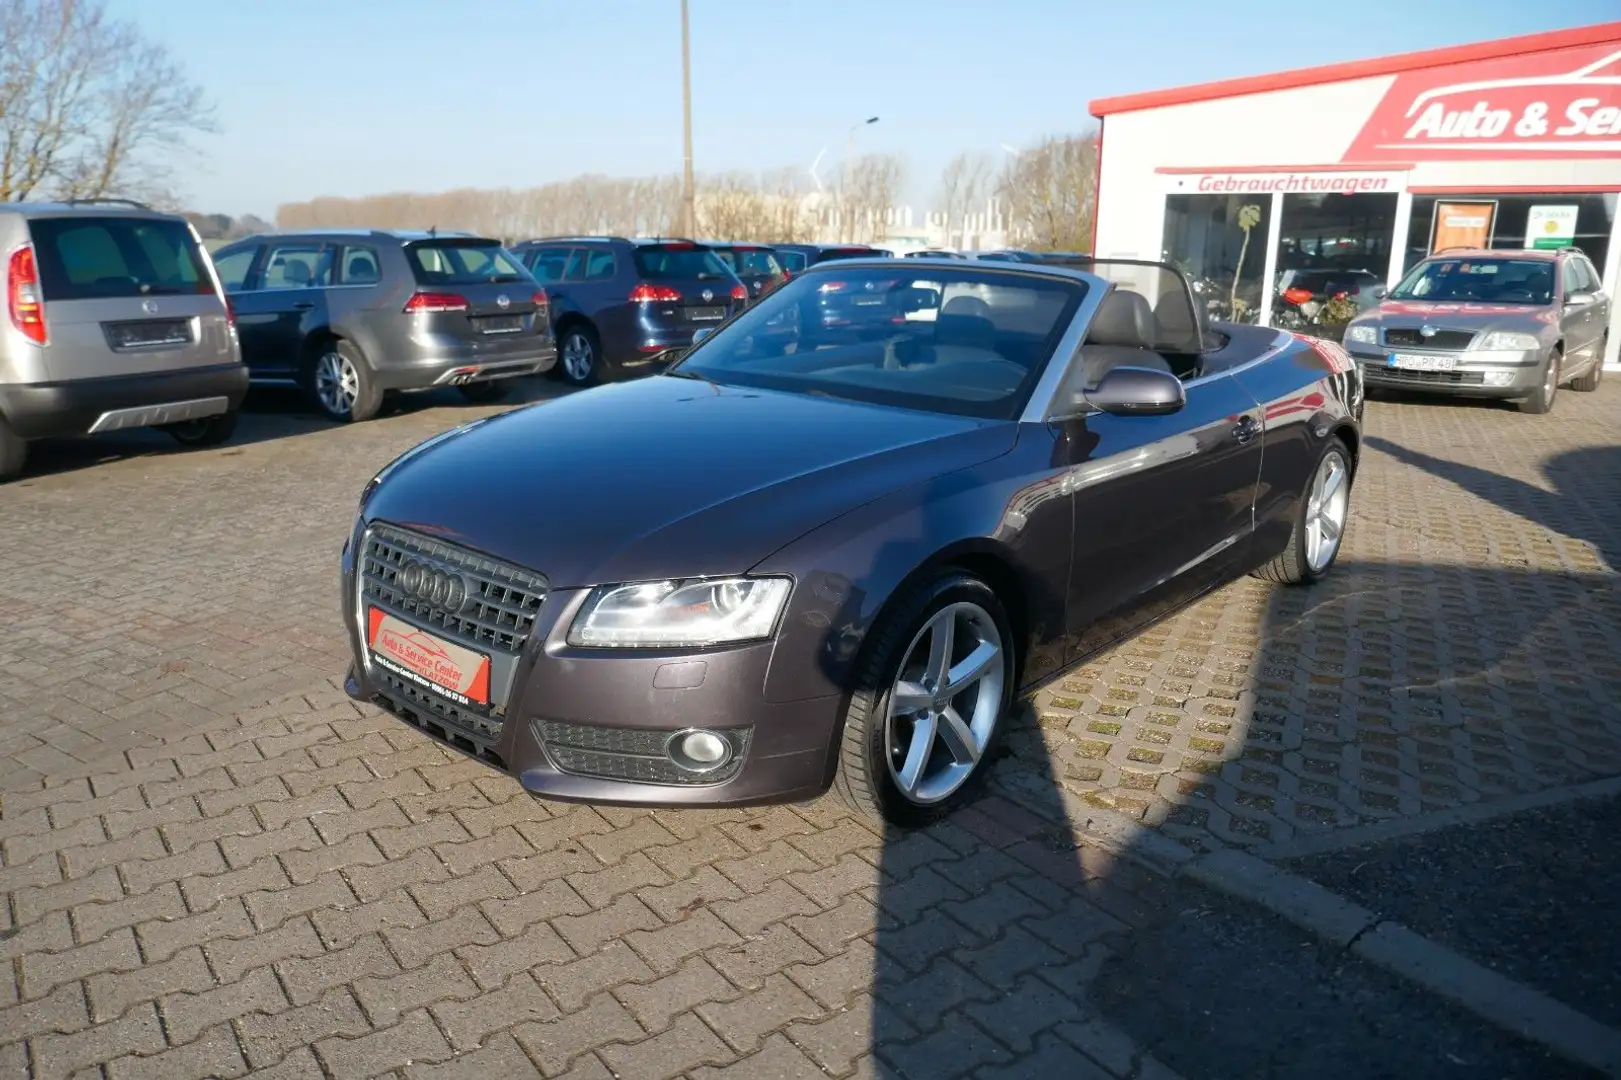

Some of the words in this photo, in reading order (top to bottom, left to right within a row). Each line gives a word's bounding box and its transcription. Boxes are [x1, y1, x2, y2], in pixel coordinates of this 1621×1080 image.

[1404, 101, 1512, 139] Auto
[1514, 101, 1549, 138] &
[1198, 174, 1388, 196] Gebrauchtwagen
[381, 635, 397, 650] Auto
[399, 643, 405, 654] &
[406, 646, 433, 667] Service
[435, 660, 463, 681] Center
